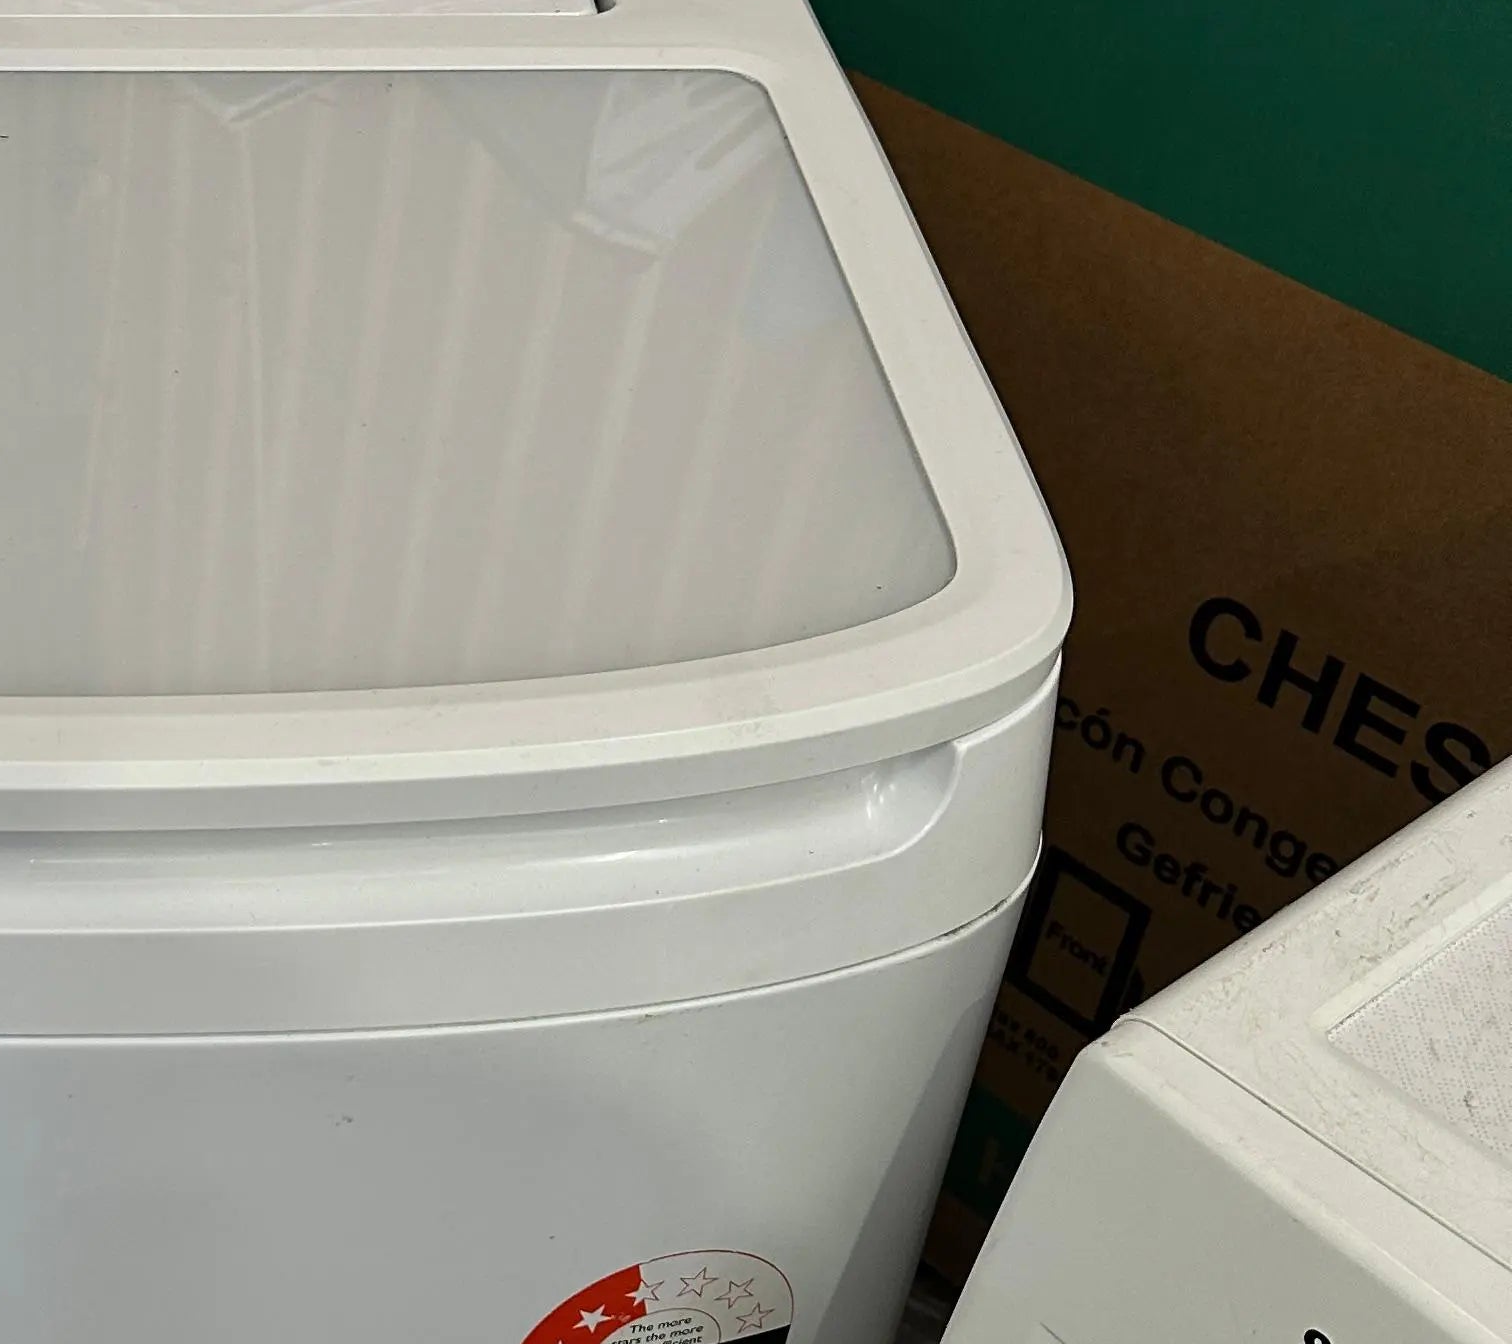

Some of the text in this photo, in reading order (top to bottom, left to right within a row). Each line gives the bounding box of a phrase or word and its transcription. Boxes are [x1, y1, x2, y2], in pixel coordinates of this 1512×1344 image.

[630, 1317, 692, 1334] The more
[646, 1332, 666, 1342] the
[670, 1324, 704, 1335] more
